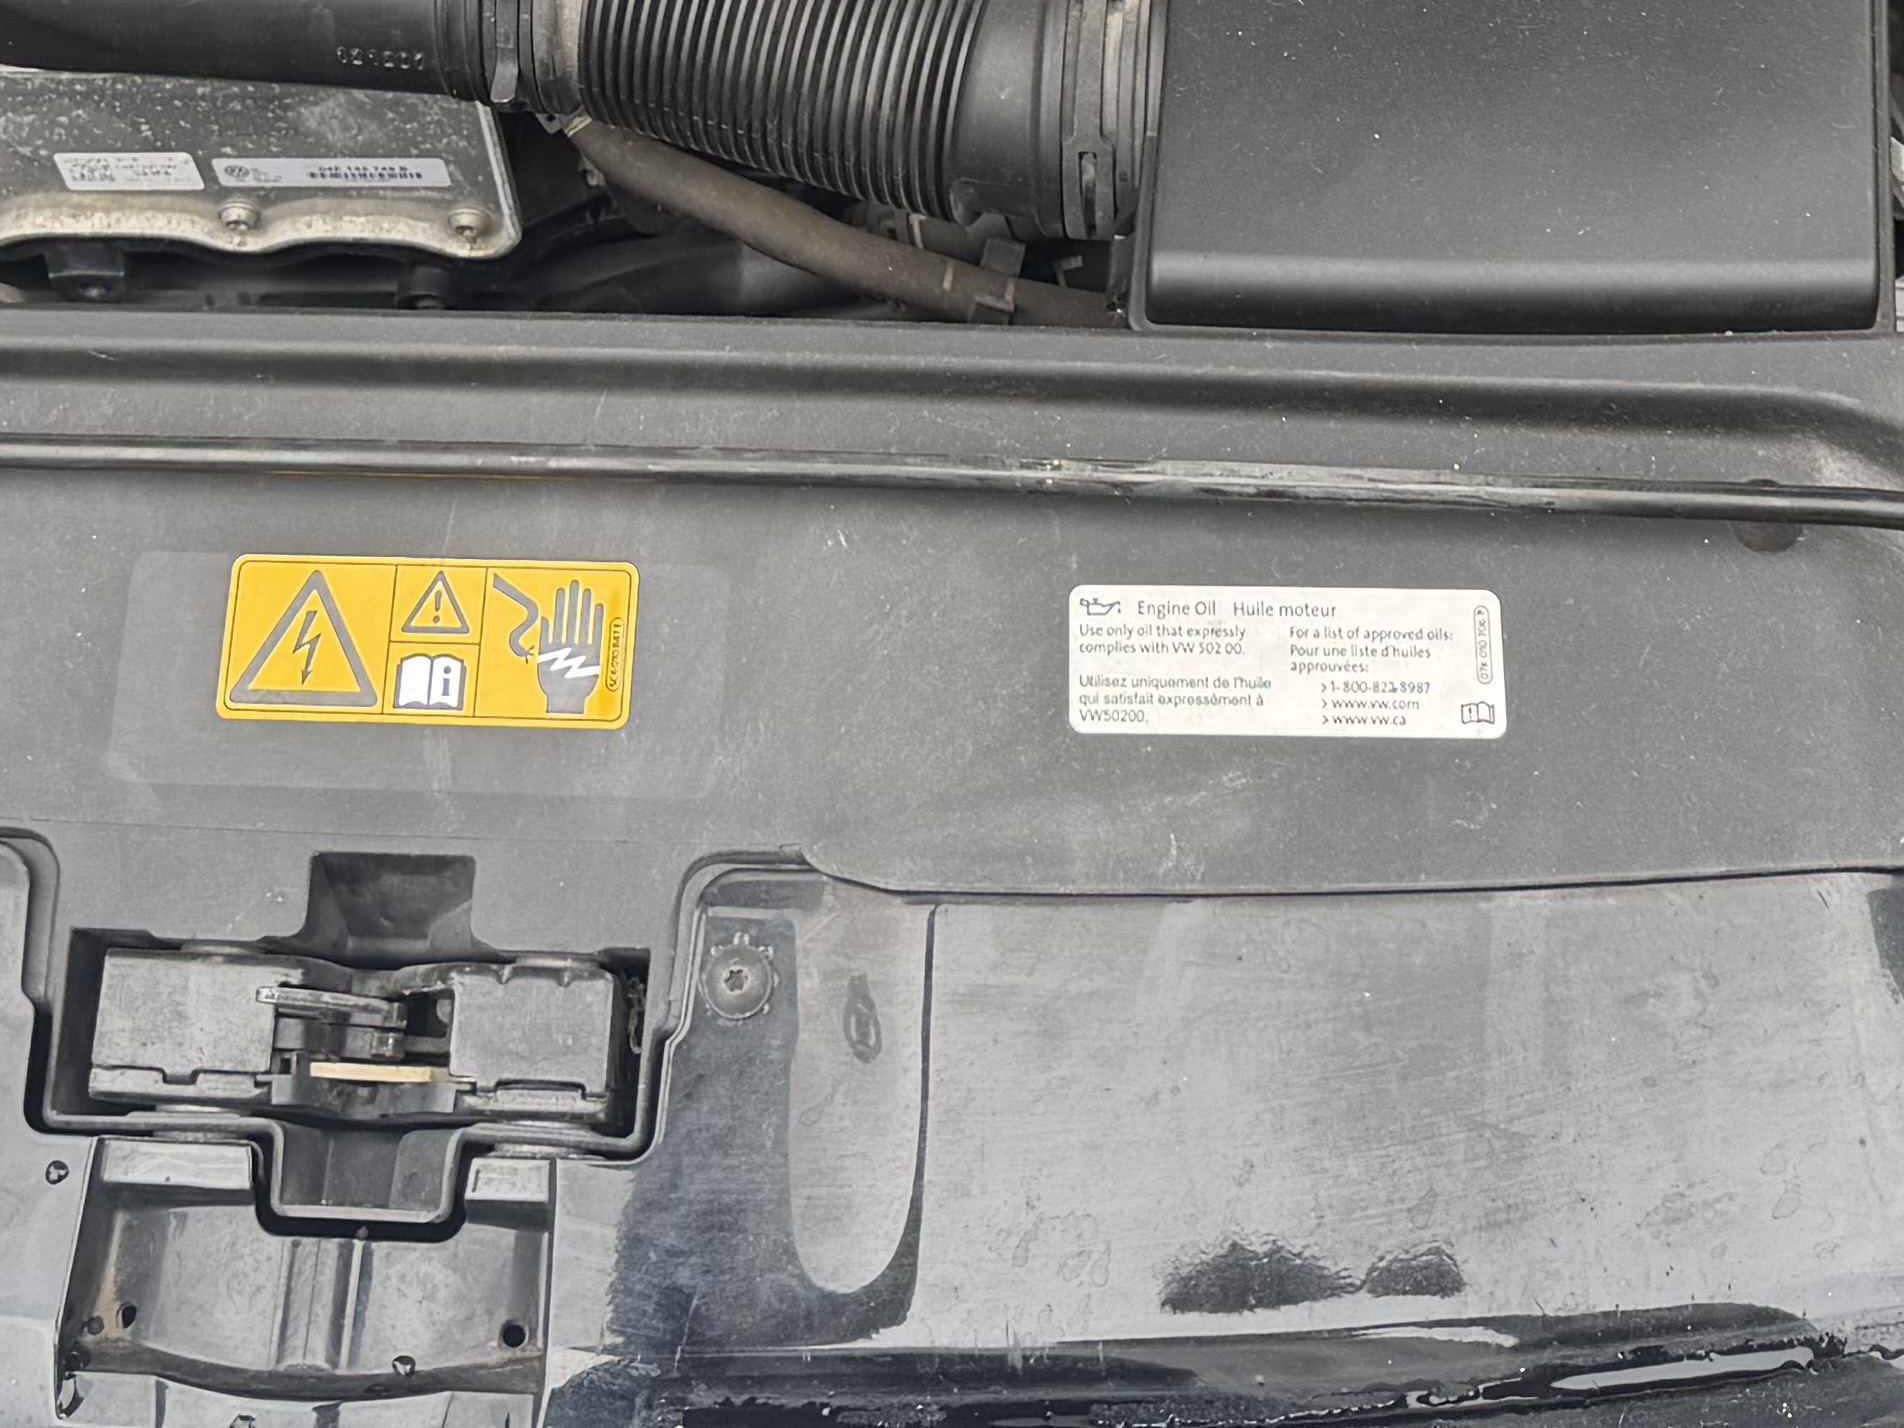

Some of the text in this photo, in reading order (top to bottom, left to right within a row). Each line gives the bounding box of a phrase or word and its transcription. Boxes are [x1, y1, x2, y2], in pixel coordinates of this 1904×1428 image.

[1137, 600, 1336, 620] Engine Oil Huile moteur
[1079, 624, 1247, 642] Use only oil that expressly
[1289, 626, 1310, 640] For
[1312, 629, 1321, 640] a
[1323, 626, 1344, 640] list
[1346, 626, 1360, 640] of
[1363, 627, 1424, 643] approved
[1079, 642, 1137, 657] complies
[1139, 642, 1169, 654] with
[1172, 643, 1195, 654] VW
[1198, 642, 1222, 655] 502
[1290, 644, 1432, 659] Pour une liste d'huiles
[1131, 674, 1209, 690] uniquement
[1212, 676, 1230, 689] de
[1079, 694, 1100, 709] qui
[1103, 693, 1154, 706] satisfait
[1255, 694, 1264, 706] à
[1332, 698, 1420, 711] www.vw.com
